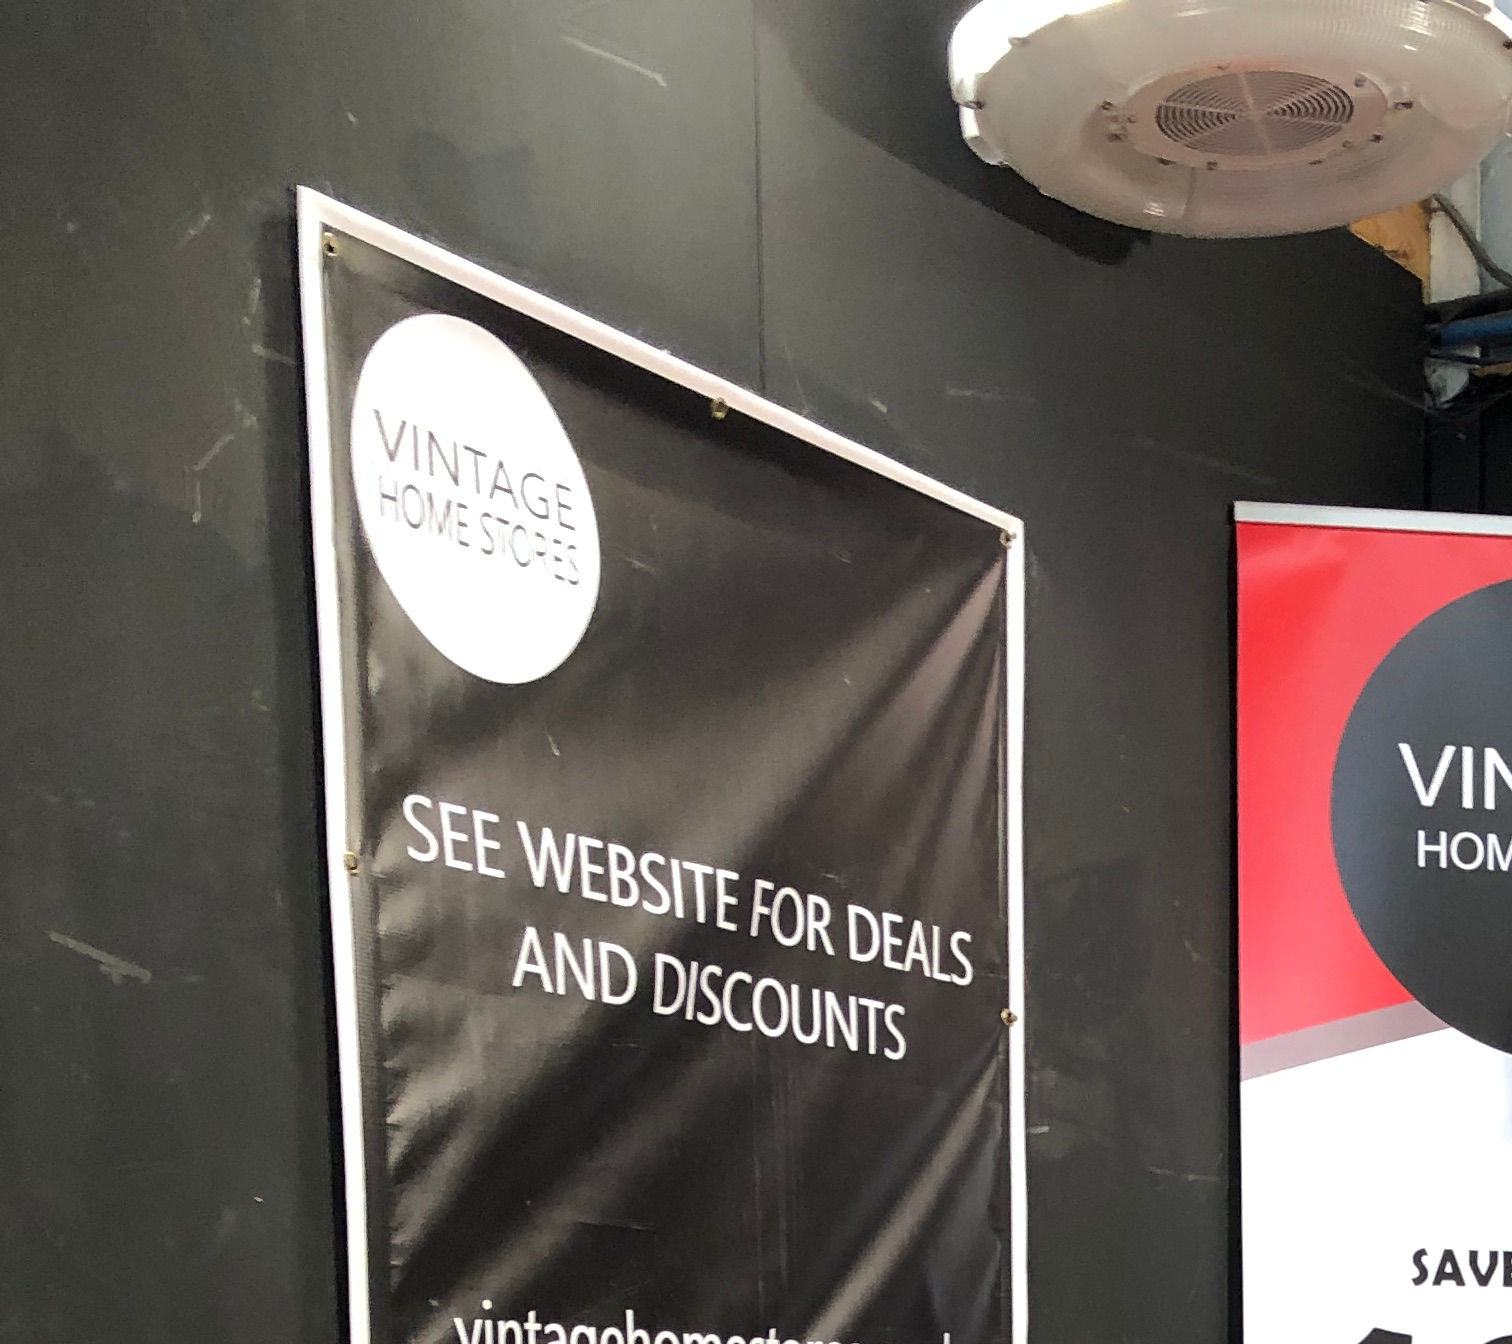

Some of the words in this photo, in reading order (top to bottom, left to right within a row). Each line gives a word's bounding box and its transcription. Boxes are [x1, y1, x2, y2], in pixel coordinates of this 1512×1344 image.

[373, 408, 576, 531] VINTAGE
[379, 474, 470, 548] HOME
[480, 512, 580, 586] STORES
[402, 794, 506, 879] SEE
[517, 820, 738, 932] WEBSITE
[750, 878, 836, 960] FOR
[849, 904, 975, 987] DEALS
[512, 926, 638, 1006] AND
[653, 952, 908, 1060] DISCOUNTS
